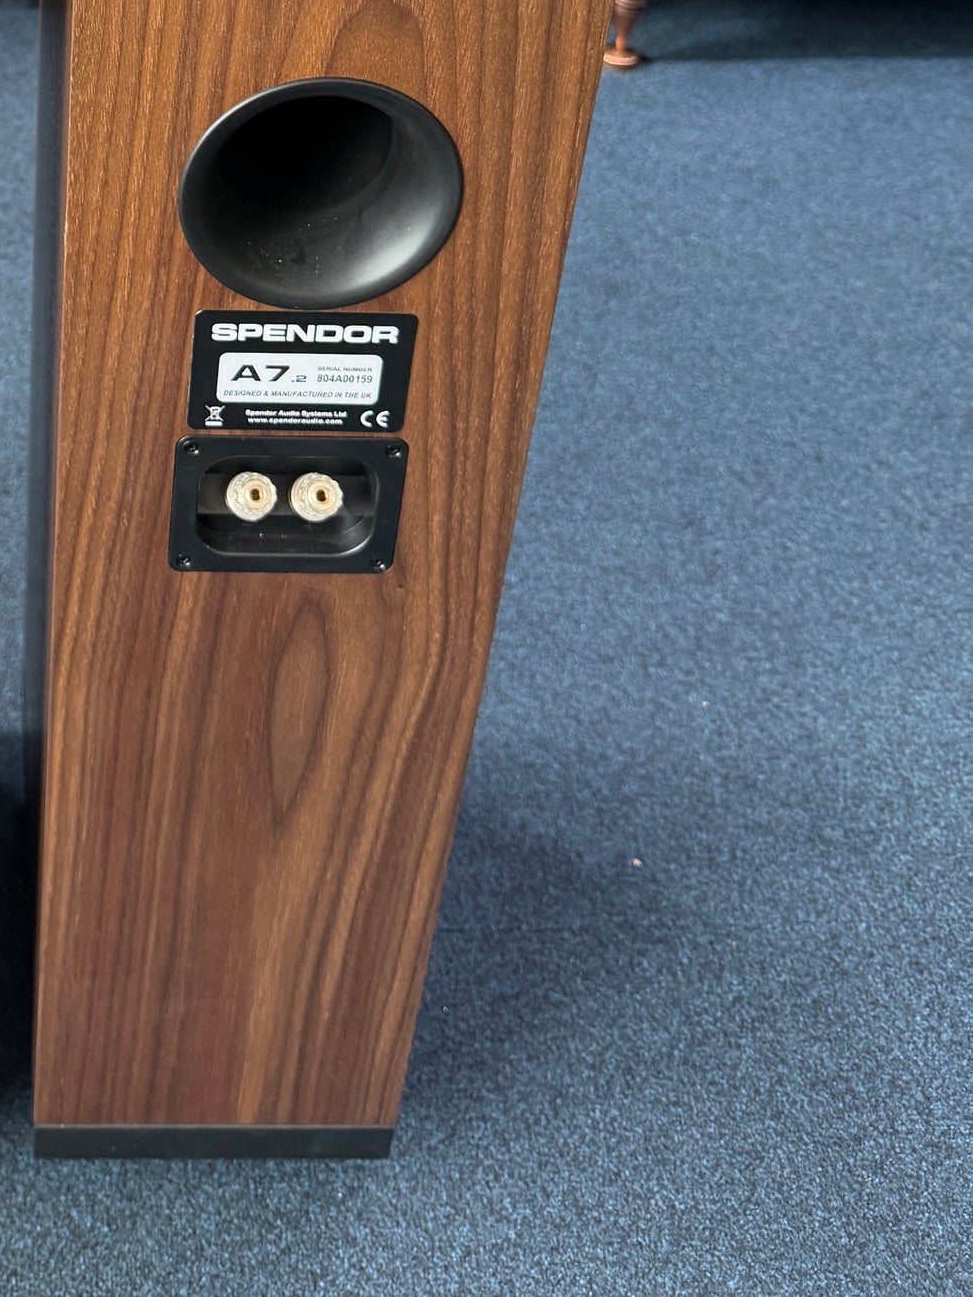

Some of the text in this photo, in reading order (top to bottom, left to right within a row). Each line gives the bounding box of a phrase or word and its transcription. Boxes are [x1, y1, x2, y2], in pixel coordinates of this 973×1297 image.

[211, 323, 399, 344] SPENDOR
[316, 374, 373, 384] 804A00159
[223, 389, 262, 397] DESIGNED
[271, 390, 333, 398] MANUFACTURED
[344, 391, 359, 399] THE
[245, 409, 347, 418] Spendor Audio Systems Ltd
[247, 417, 343, 425] www.spendoraudio.com
